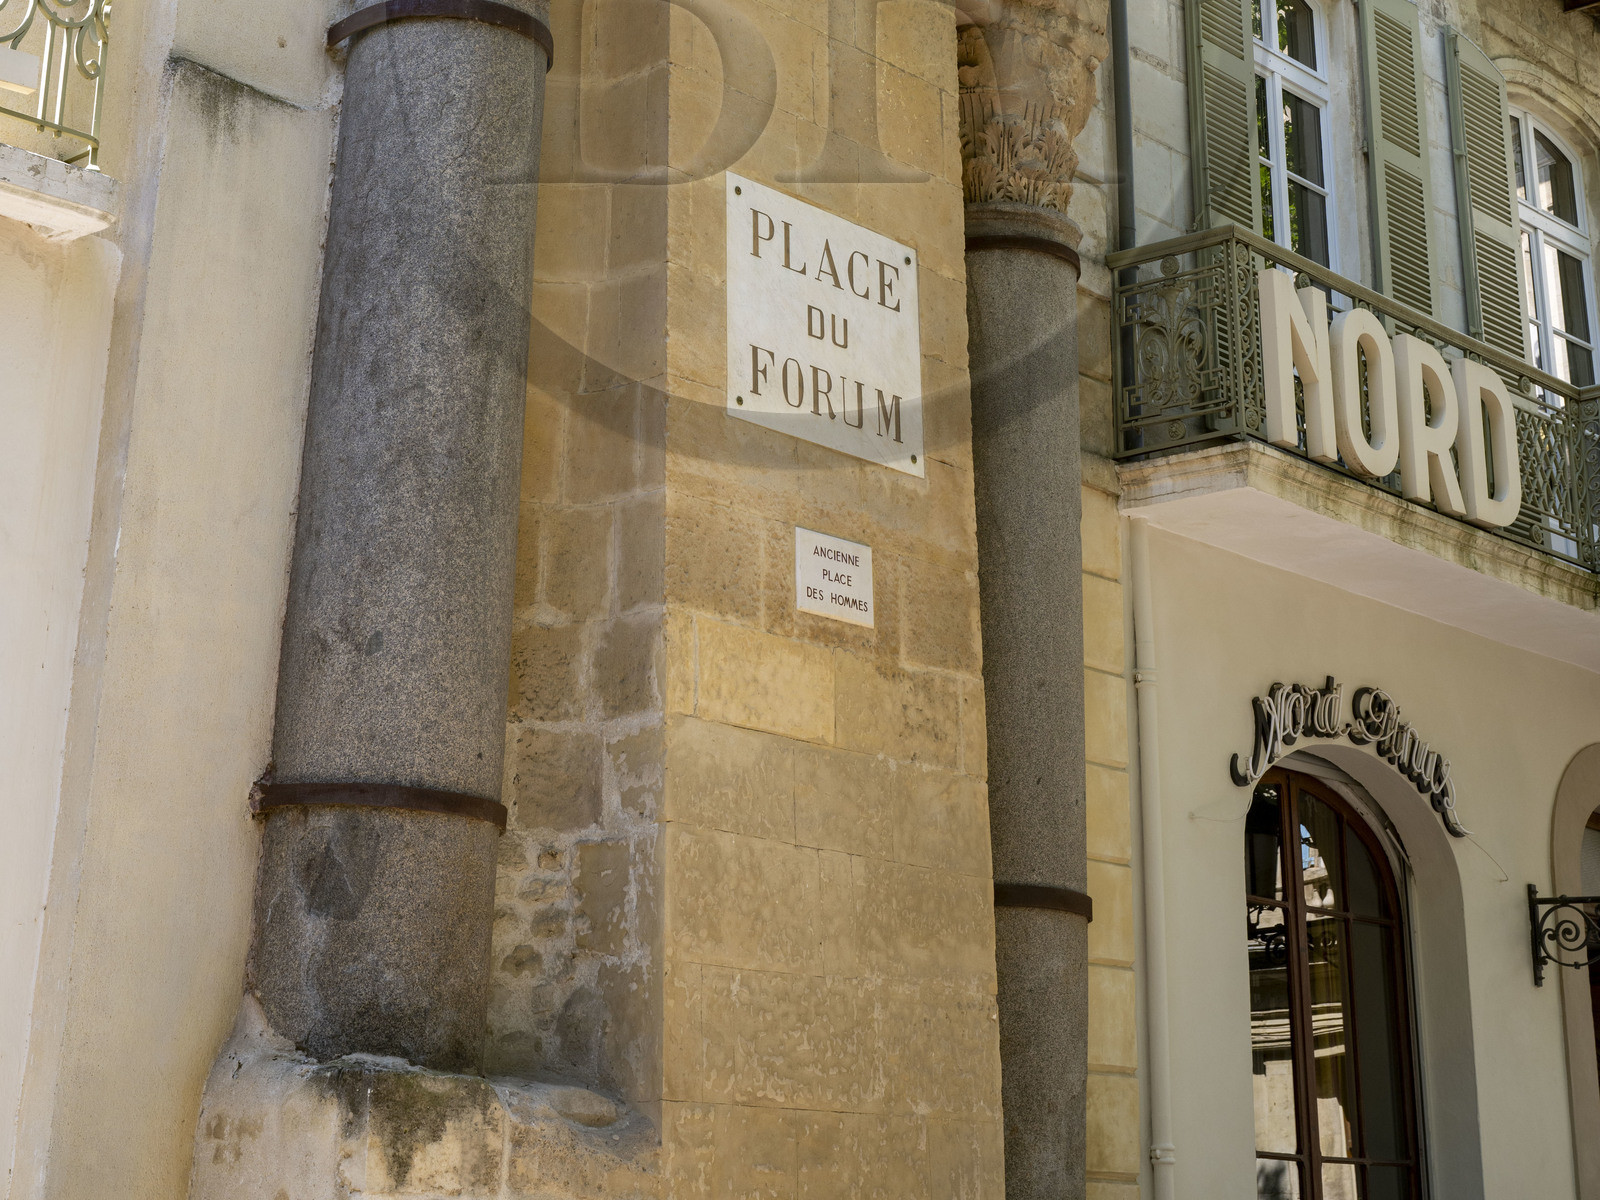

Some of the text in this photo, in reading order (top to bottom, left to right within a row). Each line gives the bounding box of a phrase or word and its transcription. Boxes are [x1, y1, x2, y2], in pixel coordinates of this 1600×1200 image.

[750, 207, 901, 313] PLACE
[807, 304, 849, 350] DU
[749, 343, 904, 444] FORUM
[1258, 267, 1521, 528] NORD
[812, 545, 860, 568] ANCIENNE
[822, 568, 852, 587] PLACE
[806, 585, 869, 613] DES HOMMES
[1229, 675, 1350, 788] Nord
